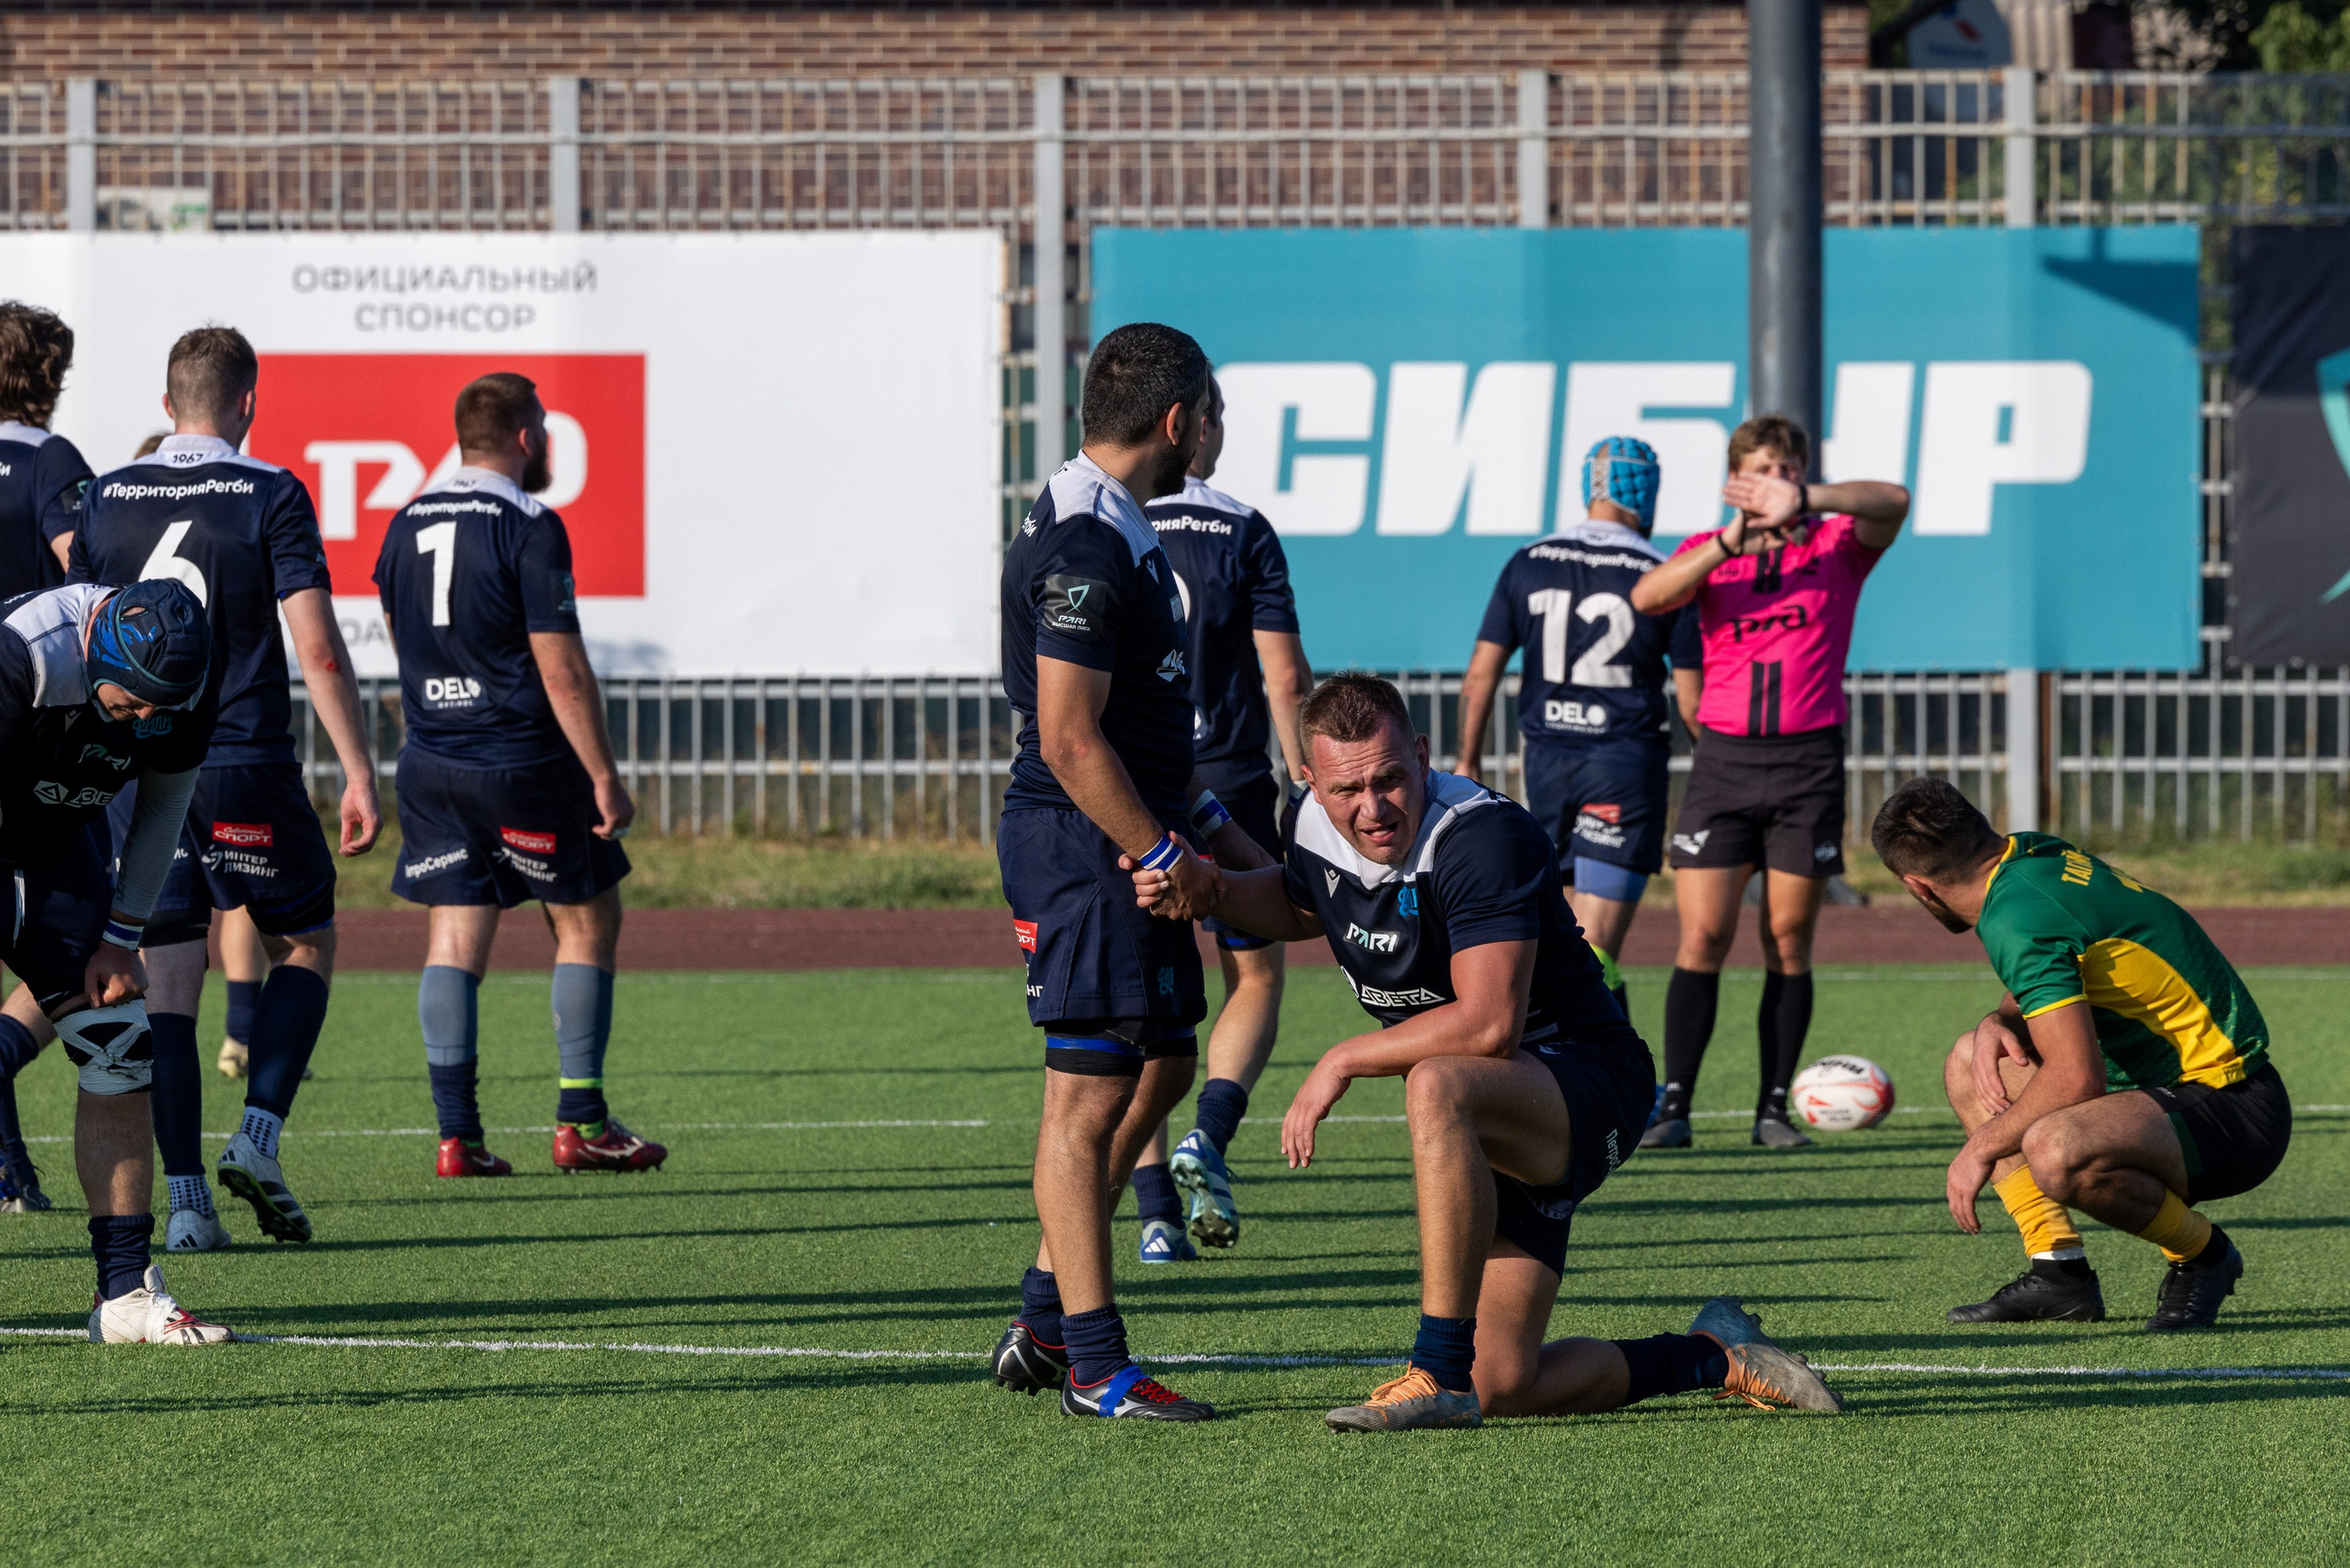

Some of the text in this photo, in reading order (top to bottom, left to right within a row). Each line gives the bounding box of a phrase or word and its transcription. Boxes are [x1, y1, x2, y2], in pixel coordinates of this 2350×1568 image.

[292, 260, 599, 294] ОФИЦИАЛЬНЫЙ
[354, 303, 536, 332] СПОНСОР
[173, 454, 204, 464] 1967
[103, 478, 254, 500] #ТерриторияРегби
[416, 521, 457, 626] 1
[1051, 622, 1077, 630] ВЫСШАЯ
[1058, 615, 1087, 625] PARI
[1528, 588, 1636, 689] 12
[1545, 700, 1607, 727] DELO
[214, 830, 272, 844] СПОРТ
[225, 850, 268, 866] ИНТЕР
[224, 862, 279, 879] ЛИЗИНГ
[1346, 922, 1398, 952] PARI
